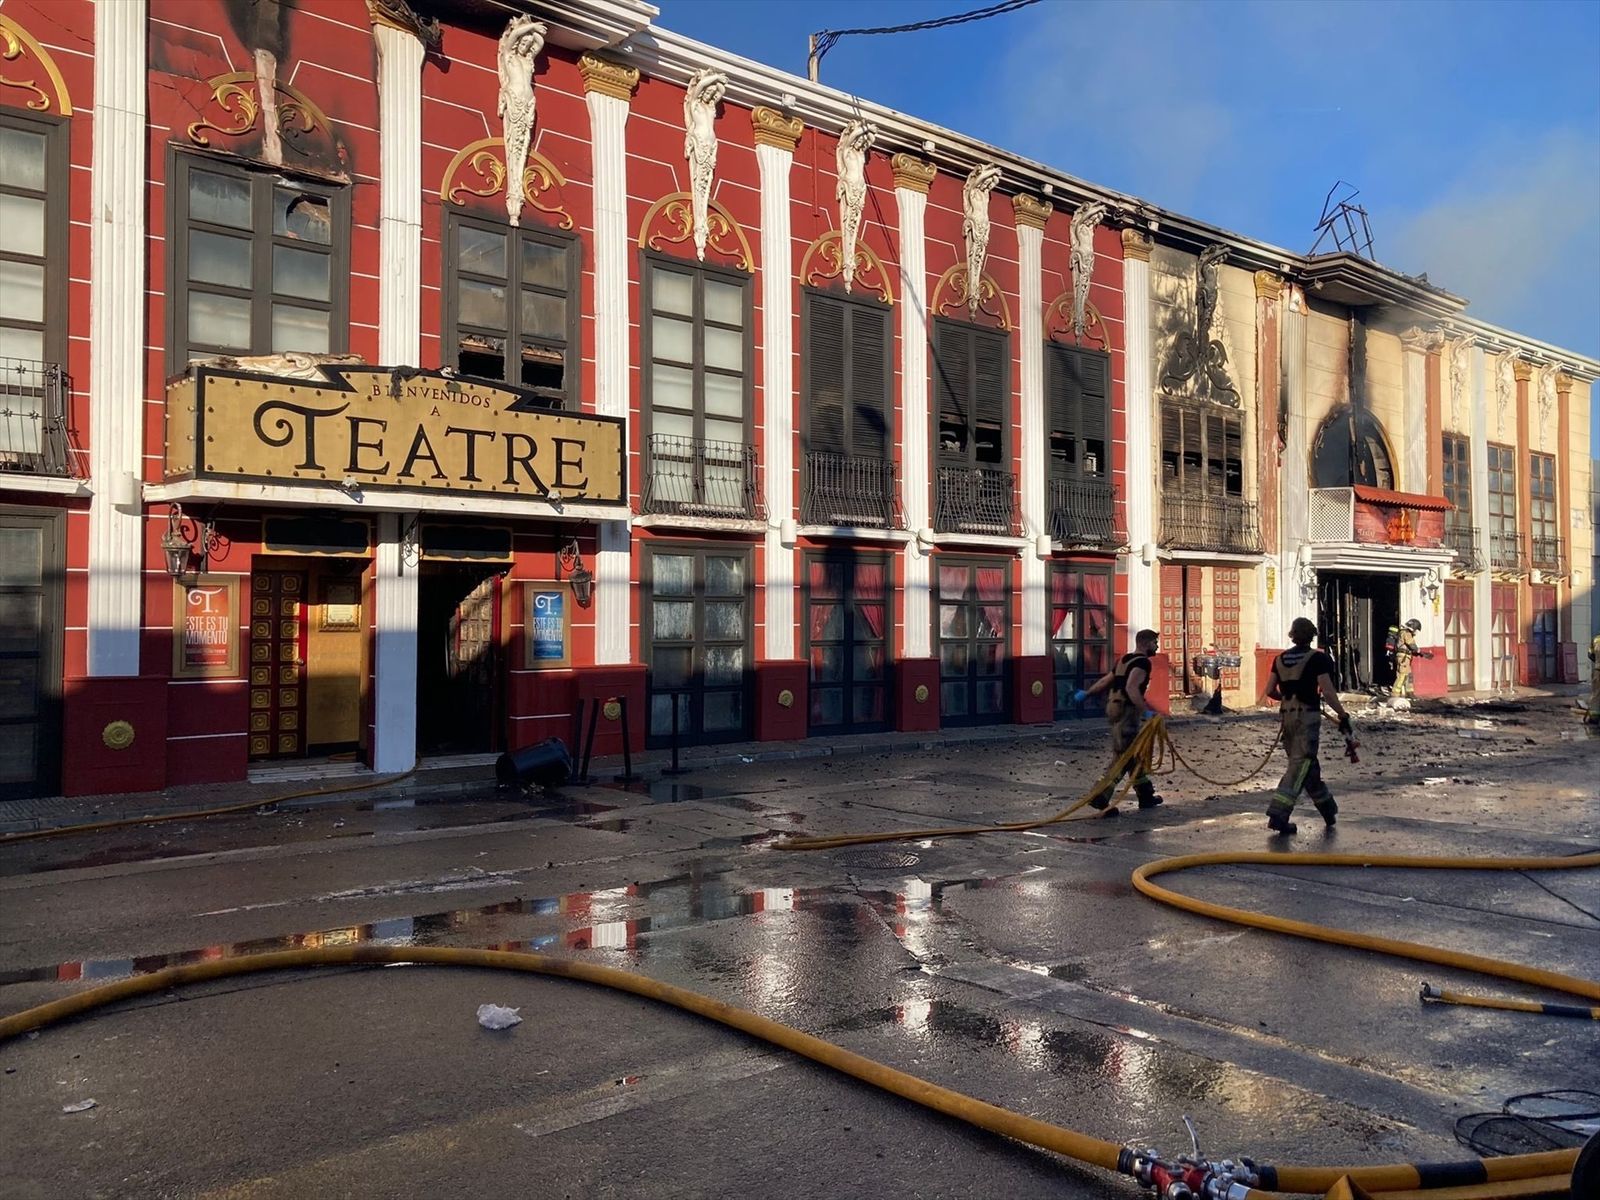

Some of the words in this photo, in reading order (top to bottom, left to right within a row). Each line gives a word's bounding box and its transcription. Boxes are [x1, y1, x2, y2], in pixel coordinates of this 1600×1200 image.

[430, 405, 440, 416] A
[253, 400, 588, 499] TEATRE
[185, 616, 204, 631] ESTE
[206, 616, 216, 631] ES
[218, 616, 229, 631] TU
[185, 630, 228, 645] MOMENTO
